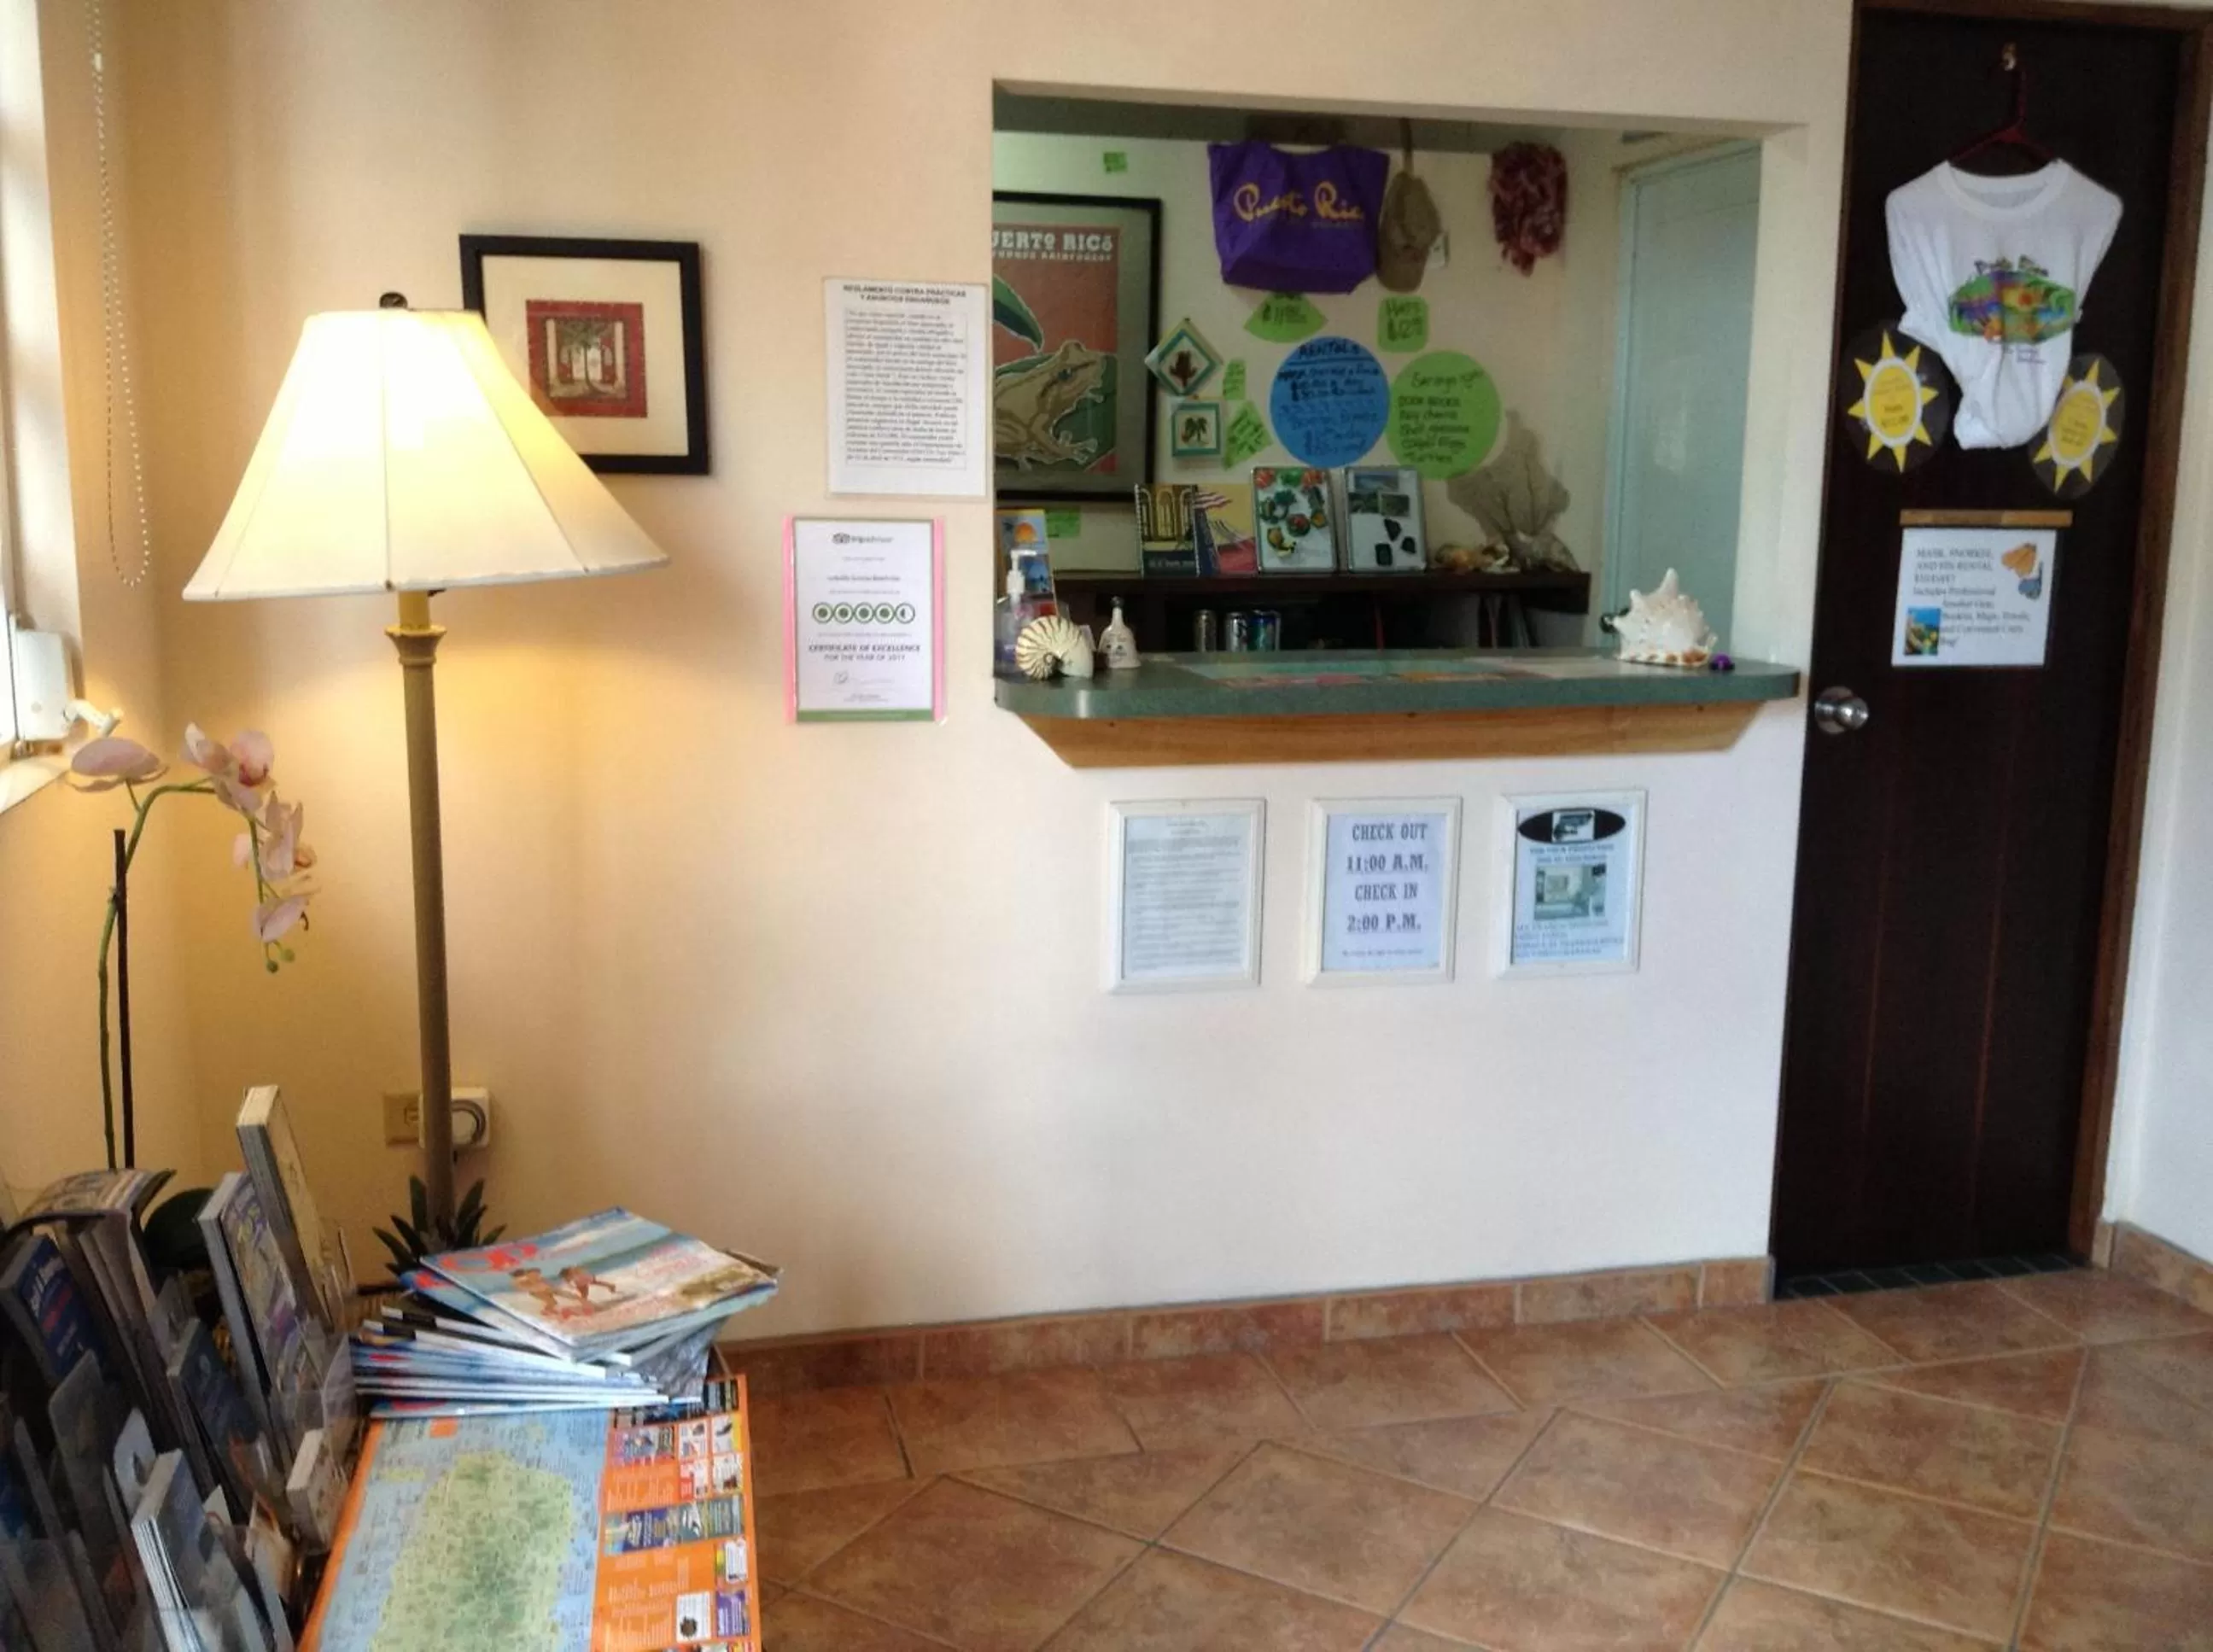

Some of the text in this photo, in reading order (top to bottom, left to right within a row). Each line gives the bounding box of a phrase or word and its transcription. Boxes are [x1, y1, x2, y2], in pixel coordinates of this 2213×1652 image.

[991, 231, 1055, 250] UERTO
[1352, 822, 1428, 842] CHECK OUT
[1346, 852, 1429, 873] 11:00 A.M.
[1354, 881, 1419, 902] CHECK IN
[1346, 912, 1422, 933] 2:00 P.M.
